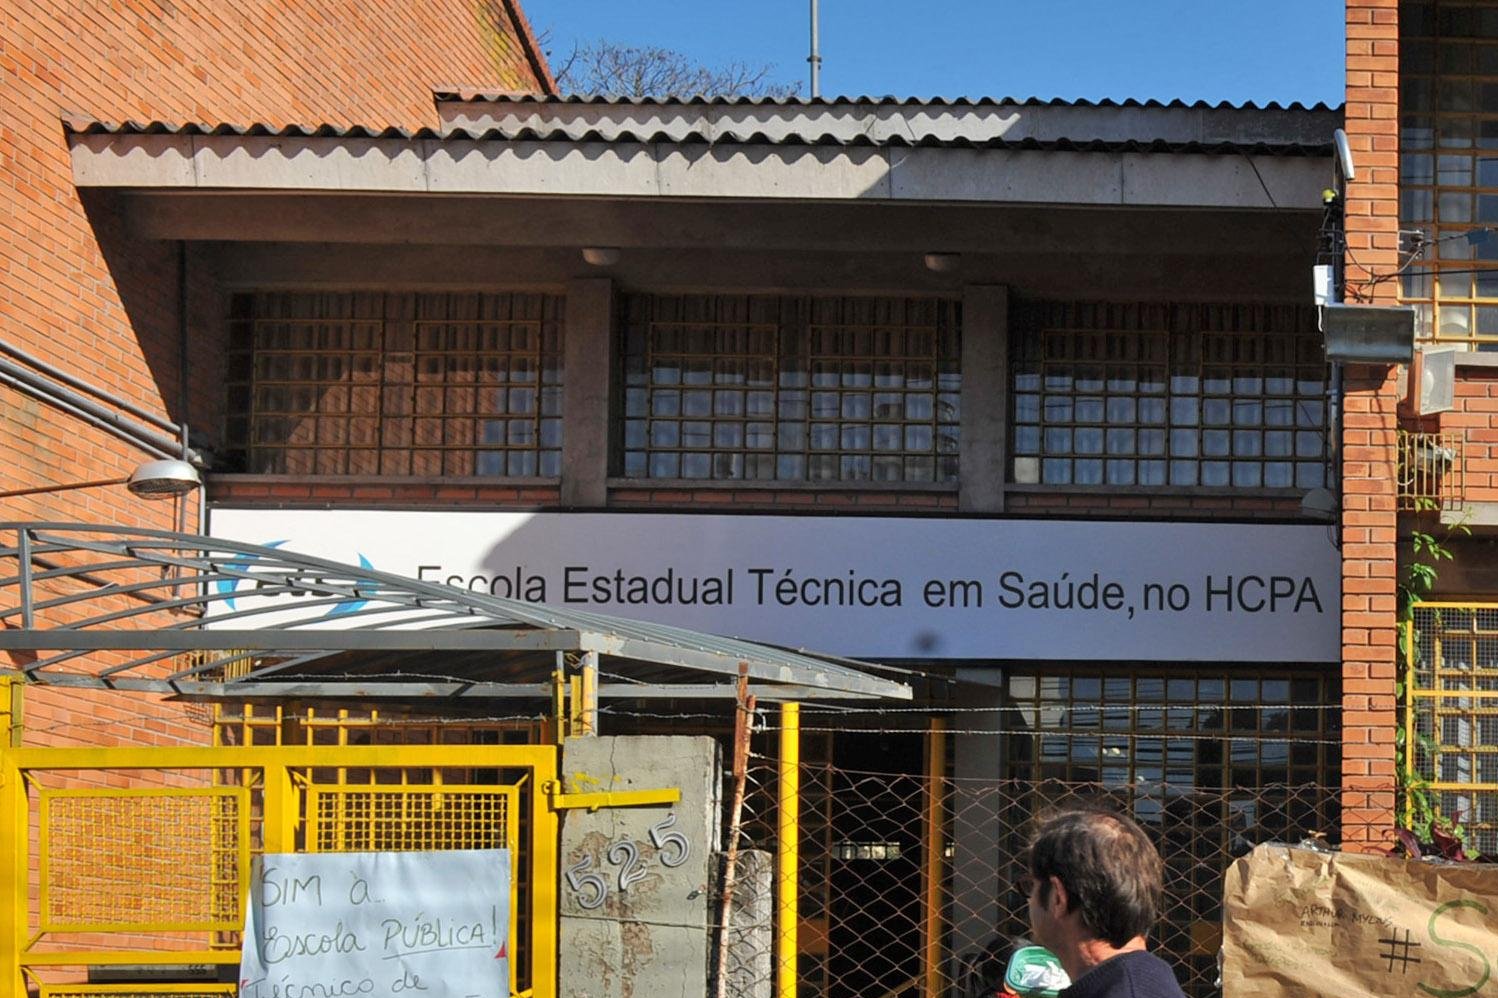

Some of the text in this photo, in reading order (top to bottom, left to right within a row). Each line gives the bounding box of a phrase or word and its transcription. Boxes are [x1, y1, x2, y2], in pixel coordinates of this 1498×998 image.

[564, 566, 733, 605] Estadual
[747, 568, 902, 608] Técnica
[923, 578, 983, 609] em
[997, 570, 1136, 620] Saúde,
[1143, 581, 1190, 612] no
[1205, 574, 1324, 614] HCPA
[565, 812, 690, 909] 525
[262, 866, 321, 907] SIM
[263, 922, 365, 965] Escola
[391, 971, 428, 993] de
